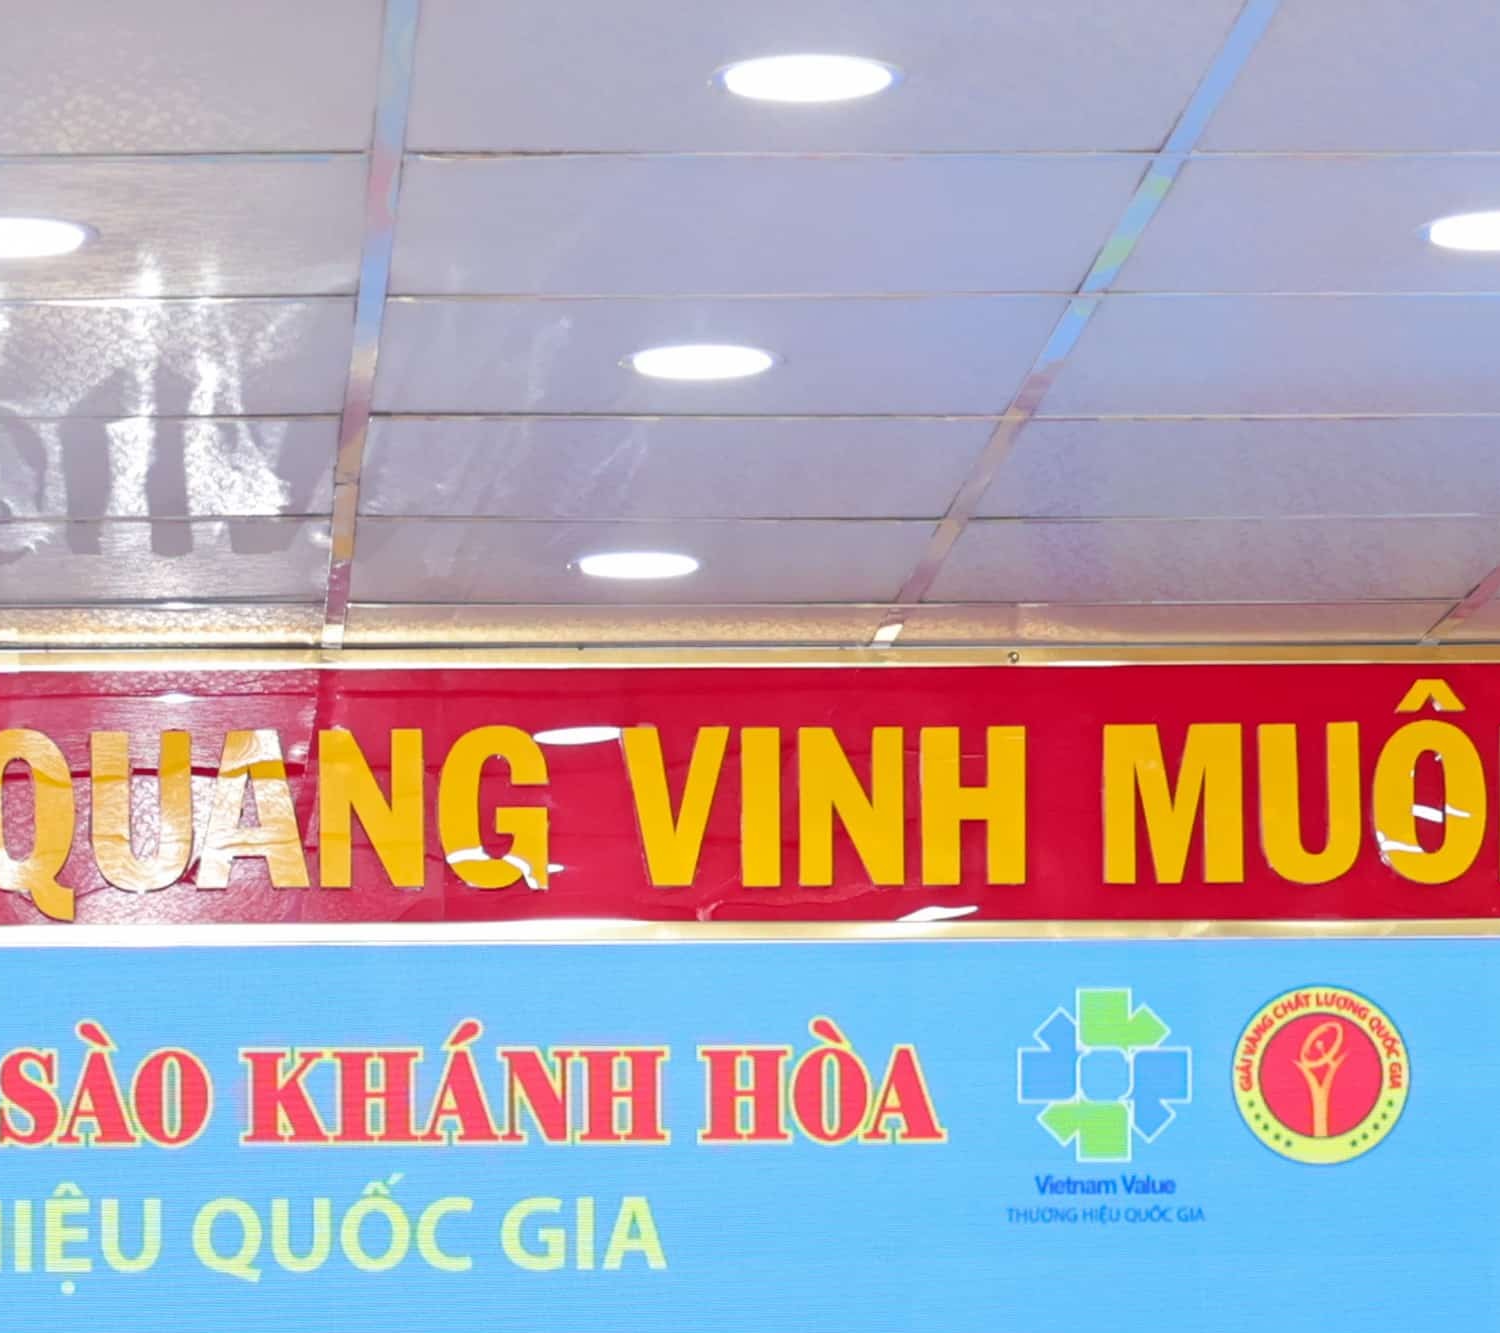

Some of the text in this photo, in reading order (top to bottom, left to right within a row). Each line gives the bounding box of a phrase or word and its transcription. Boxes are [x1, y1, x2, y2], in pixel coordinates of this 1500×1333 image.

[623, 725, 1025, 887] VINH
[238, 1020, 670, 1147] KHÁNH
[697, 1015, 947, 1147] HÒA
[193, 1173, 473, 1283] QUỐC
[501, 1197, 666, 1272] GIA
[1034, 1173, 1177, 1196] Vietnam Value
[1176, 1206, 1205, 1223] GIA
